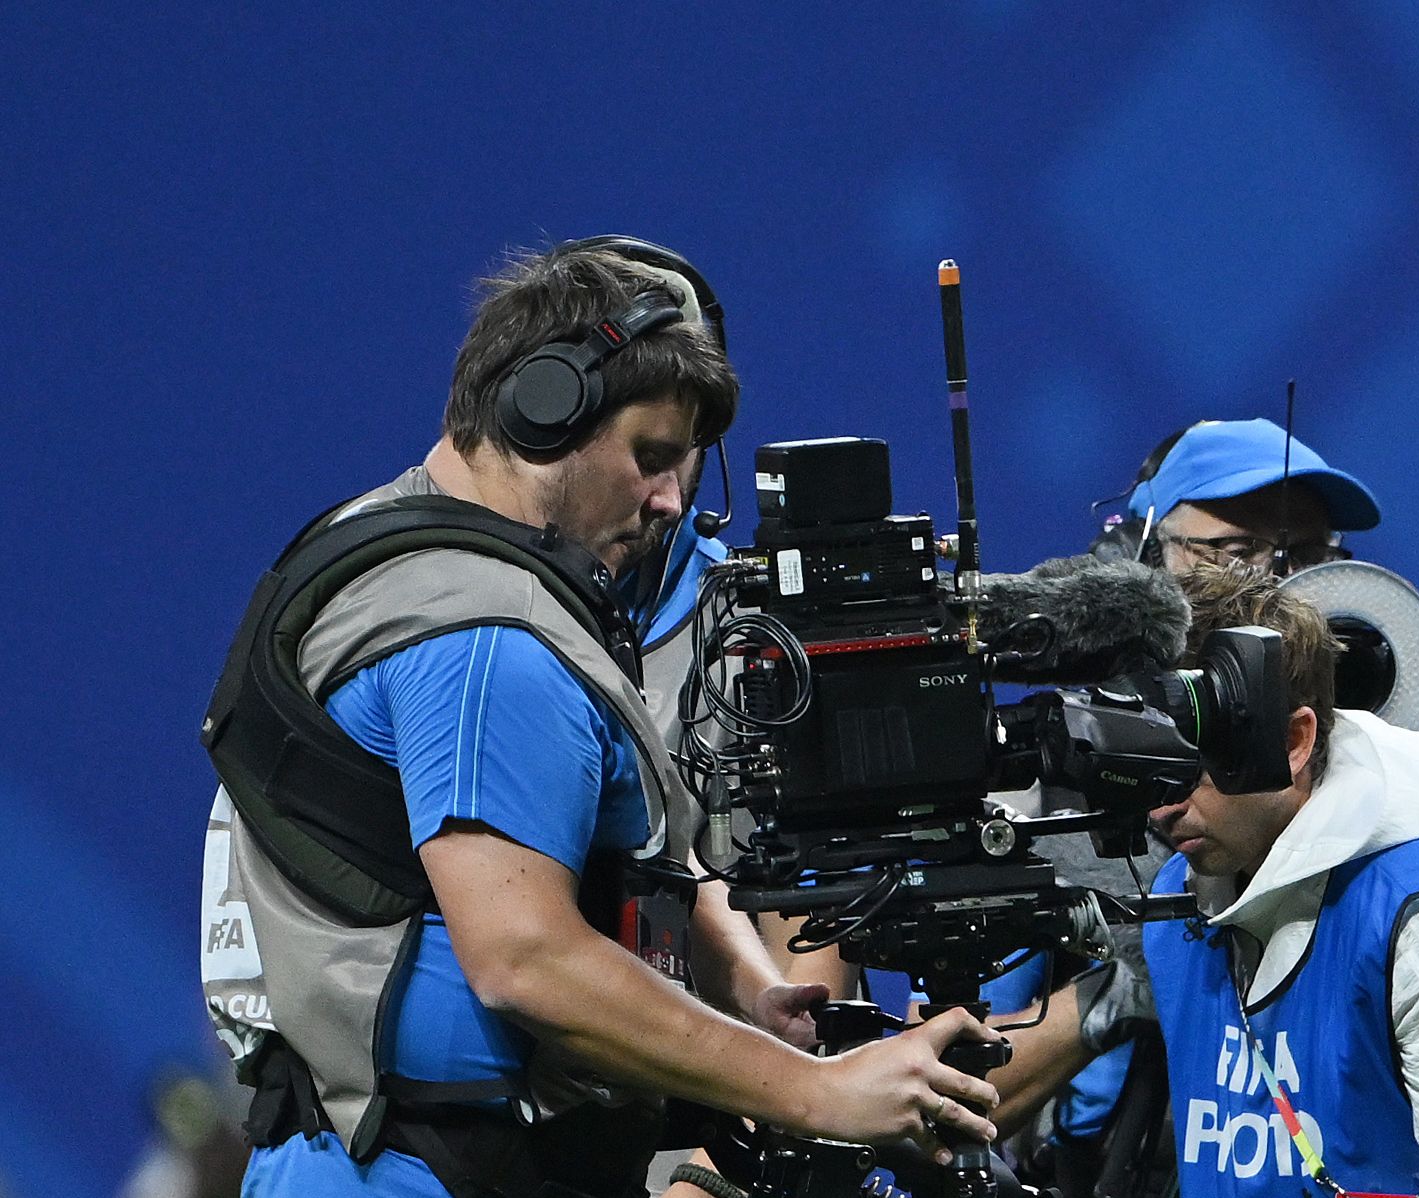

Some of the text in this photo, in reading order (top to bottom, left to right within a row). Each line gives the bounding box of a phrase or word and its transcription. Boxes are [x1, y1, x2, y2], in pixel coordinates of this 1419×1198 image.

[919, 674, 968, 688] SONY
[1101, 769, 1138, 786] Canon
[228, 994, 272, 1019] CU
